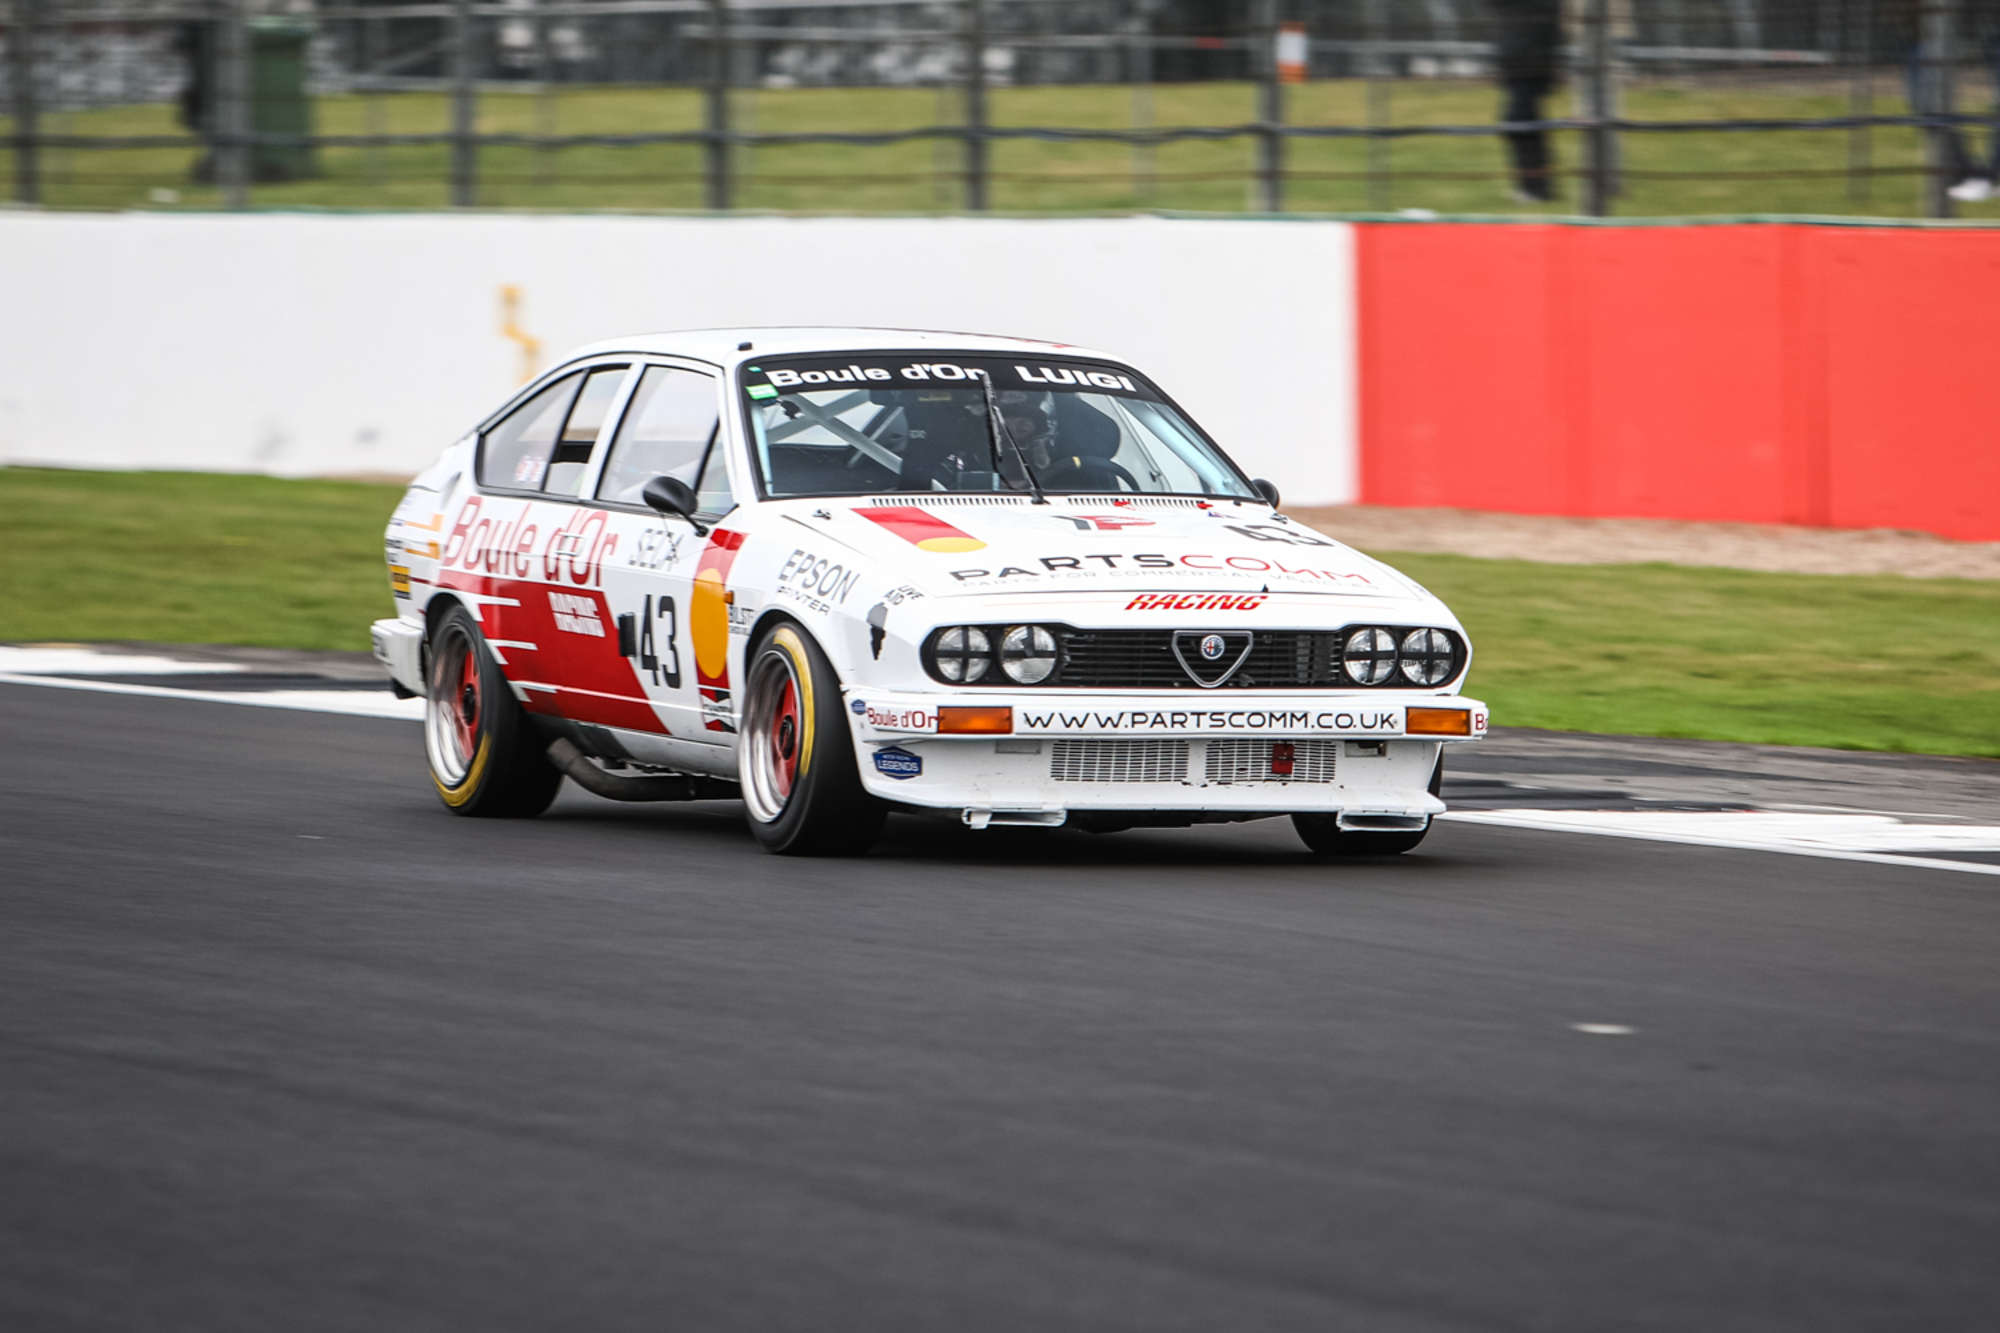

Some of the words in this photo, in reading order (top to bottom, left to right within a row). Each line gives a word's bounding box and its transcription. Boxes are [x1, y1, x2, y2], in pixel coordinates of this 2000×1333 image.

[765, 365, 892, 387] Boule
[900, 363, 987, 381] d'Or
[1014, 365, 1137, 392] LUIGI
[442, 496, 539, 578] Boule
[544, 508, 619, 587] d'Or
[778, 549, 861, 604] EPSON
[949, 554, 1372, 583] PARTSCOMM
[884, 589, 905, 606] AID
[897, 584, 925, 600] LIVE
[1123, 594, 1269, 611] RACING
[641, 594, 682, 689] 43
[866, 707, 898, 728] Boule
[901, 710, 944, 729] d'Or
[1024, 711, 1395, 729] WWW.PARTSCOMM.CO.UK
[877, 759, 919, 772] LEGENDS
